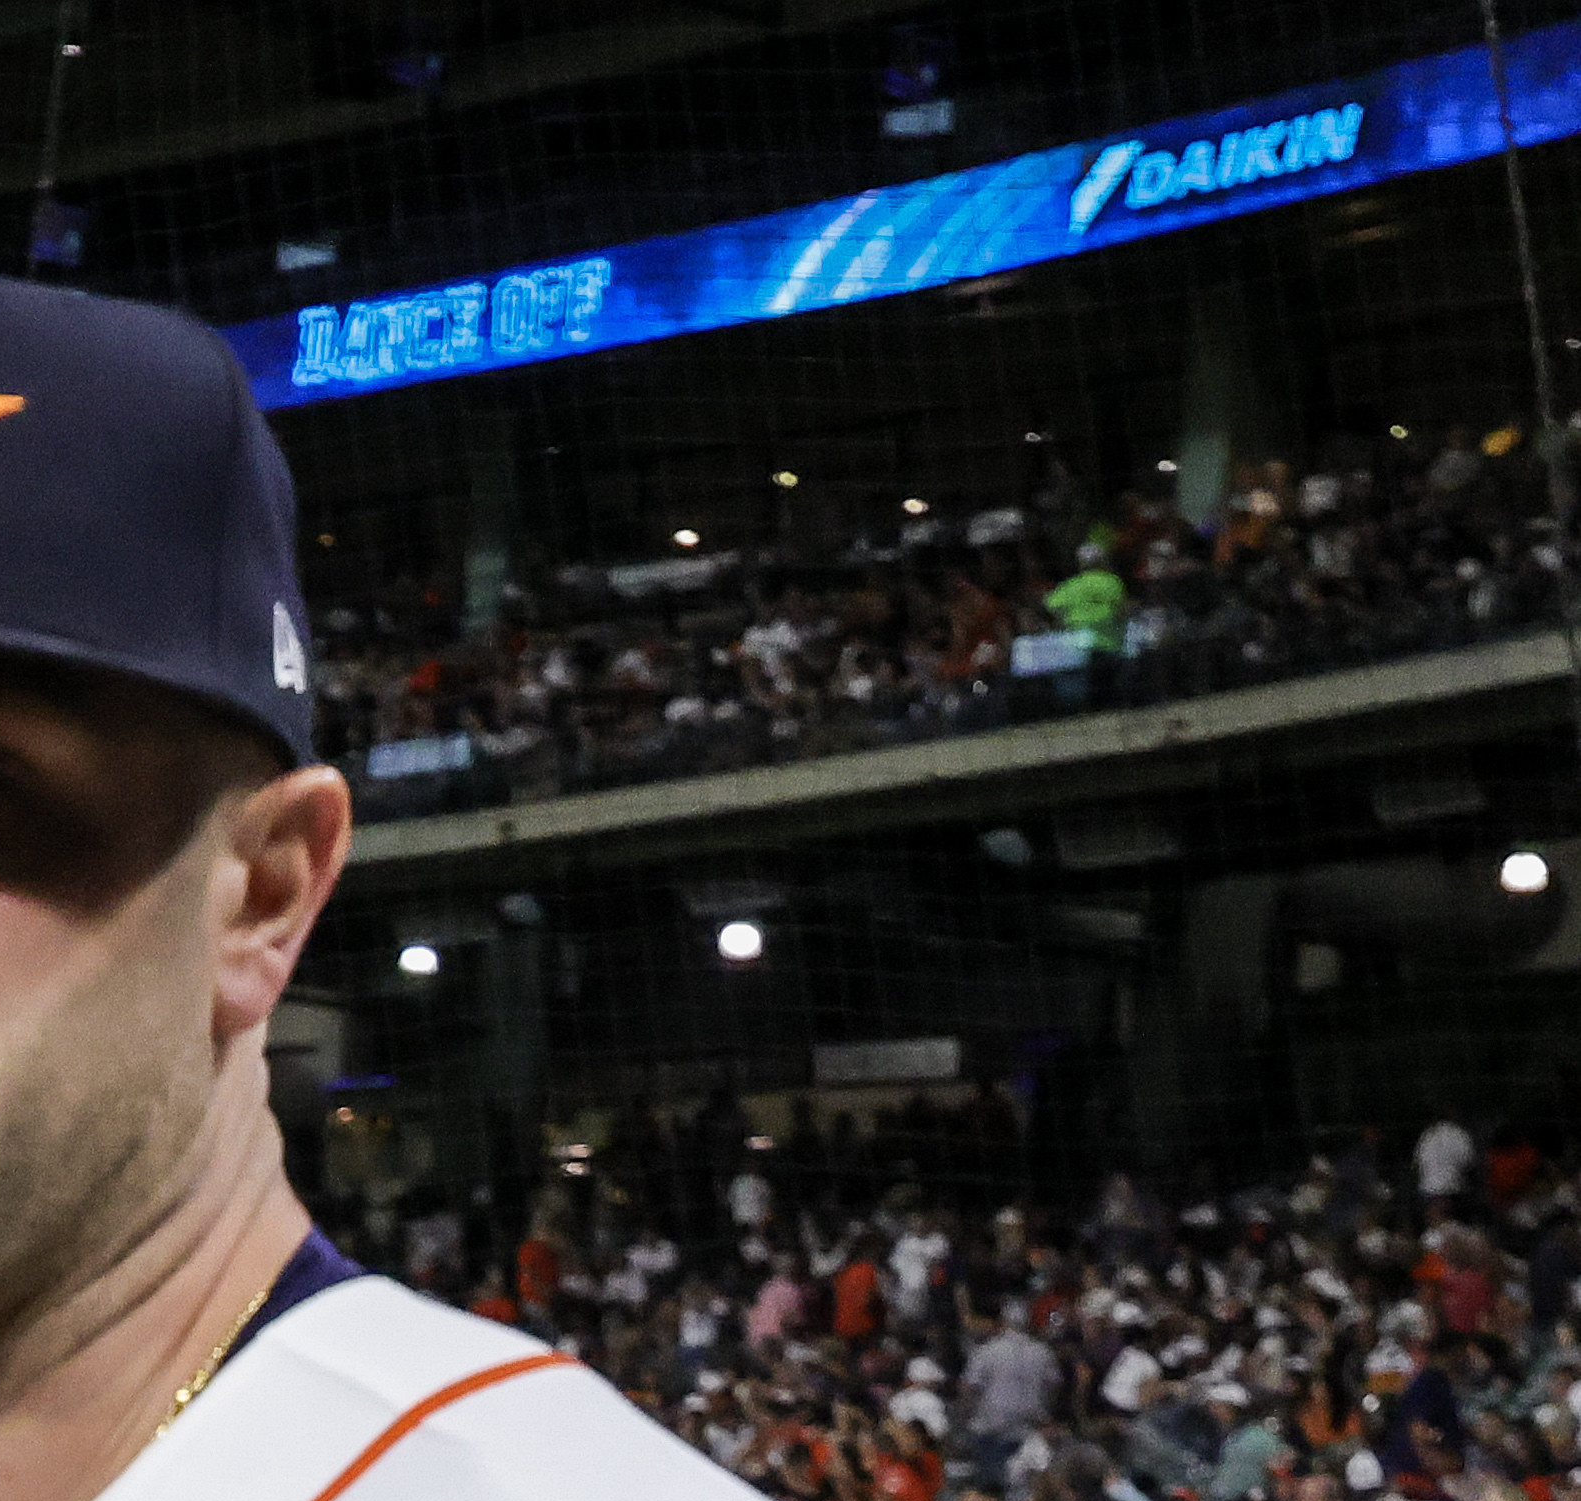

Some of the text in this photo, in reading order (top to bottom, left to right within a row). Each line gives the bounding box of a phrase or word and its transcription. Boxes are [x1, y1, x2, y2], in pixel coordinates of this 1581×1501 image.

[1124, 102, 1364, 210] DAIKIN
[292, 257, 611, 386] DANCE OFF
